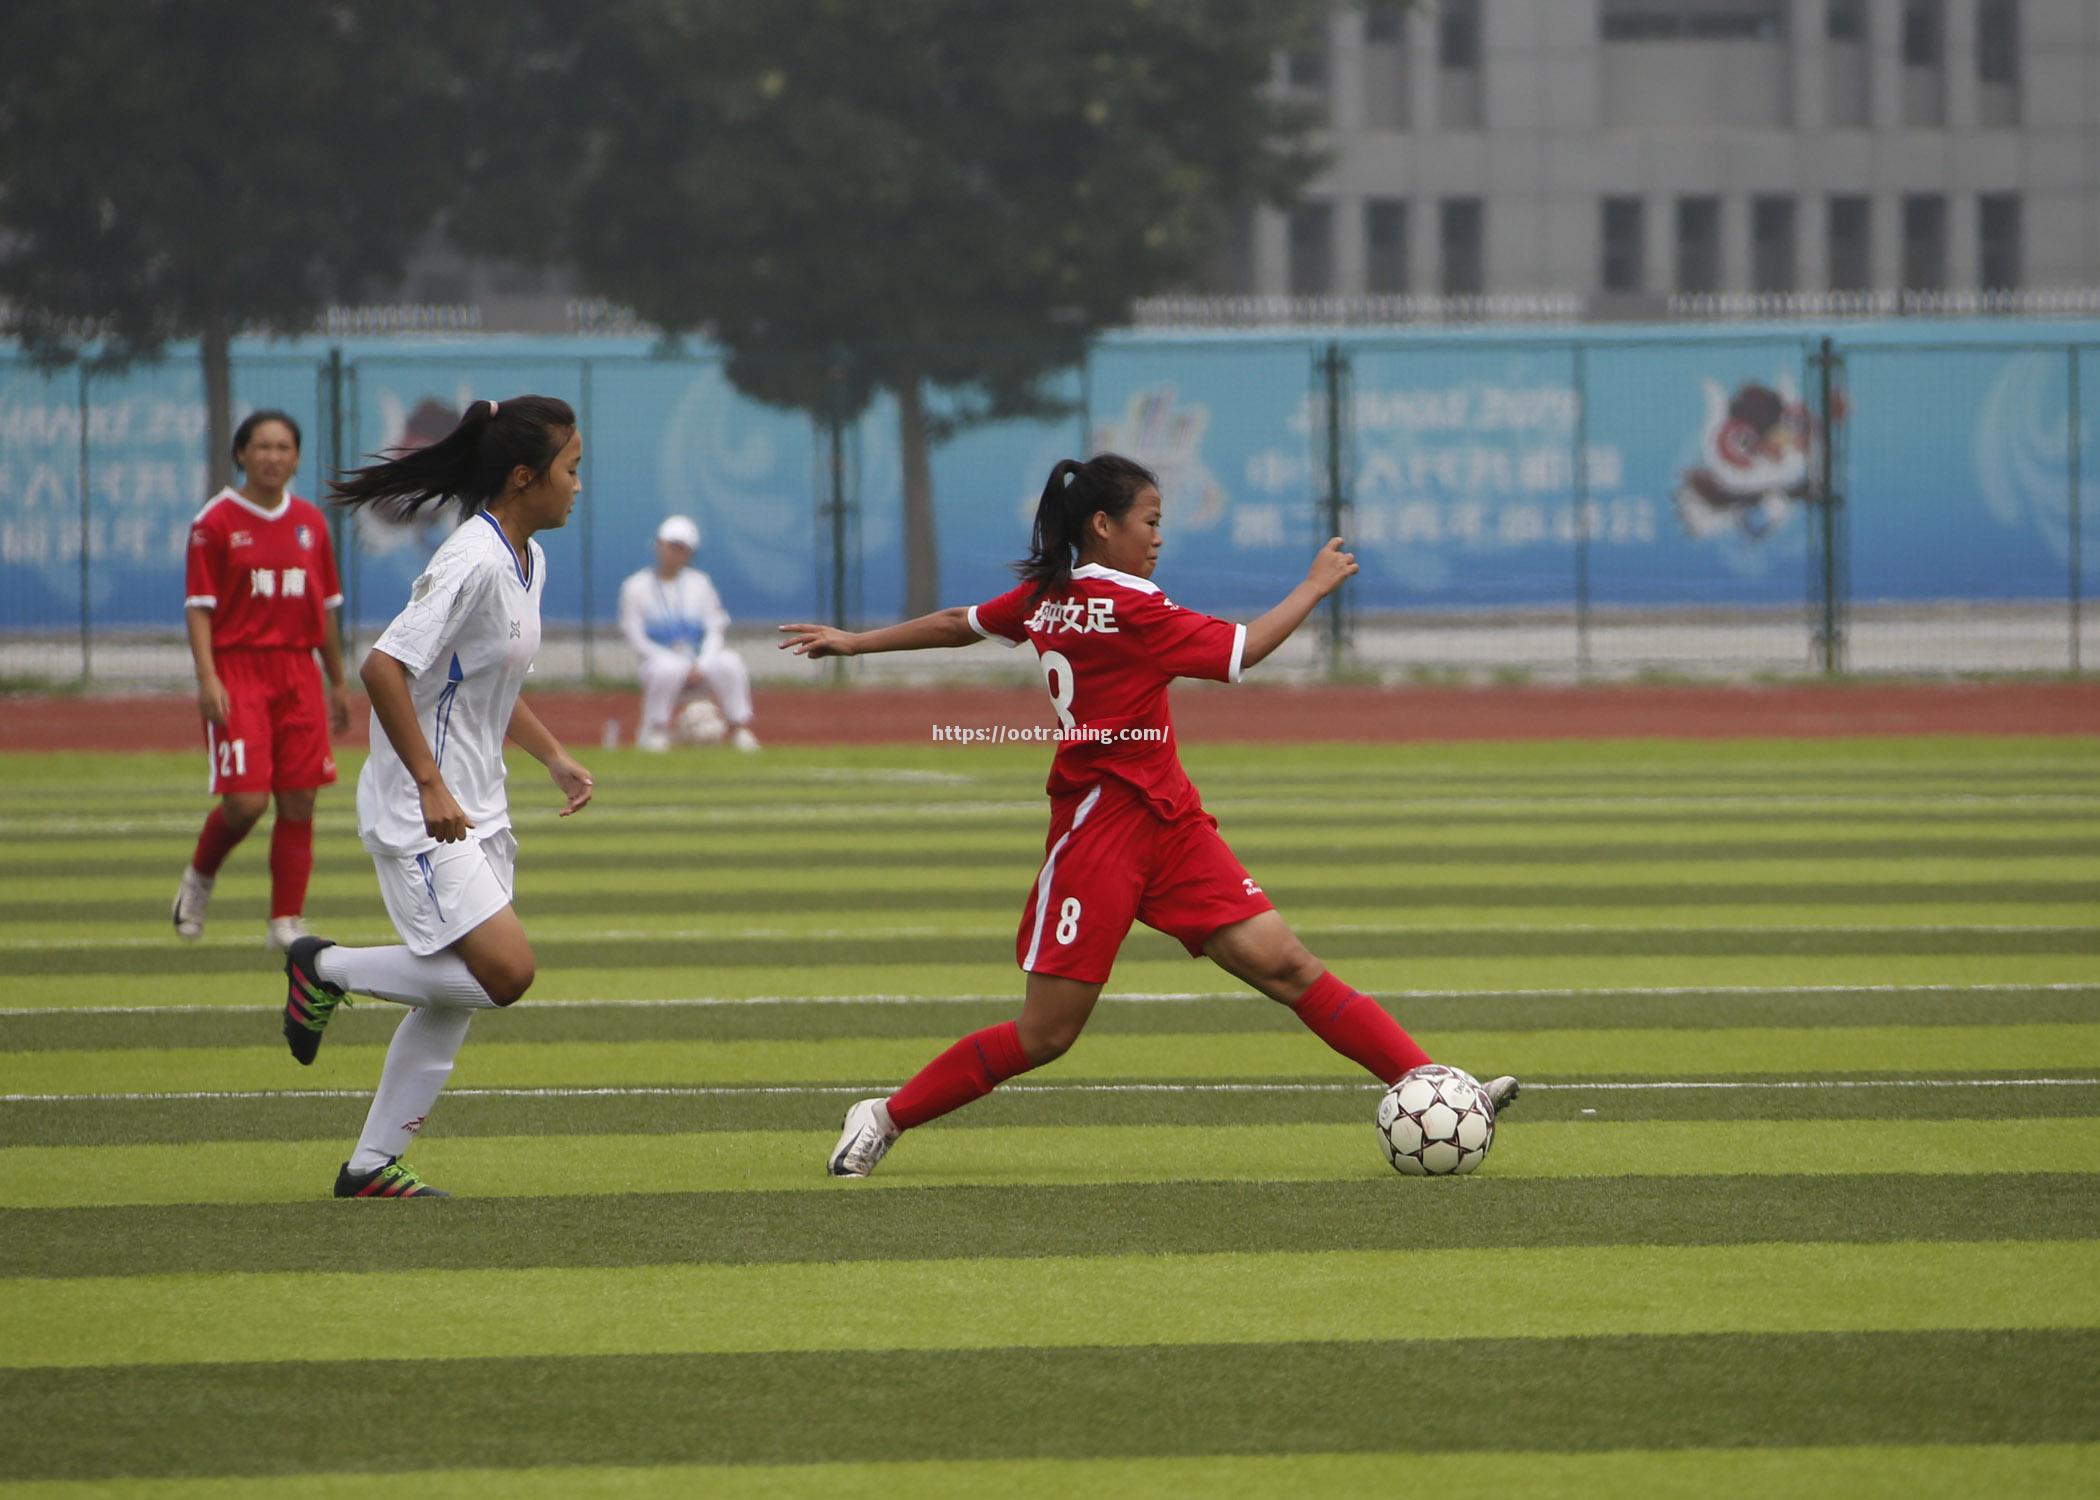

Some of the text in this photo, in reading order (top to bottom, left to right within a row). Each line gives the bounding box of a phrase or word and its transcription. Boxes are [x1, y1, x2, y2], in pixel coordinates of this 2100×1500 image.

[250, 567, 307, 598] 海南
[219, 738, 246, 777] 21
[1056, 897, 1081, 945] 8
